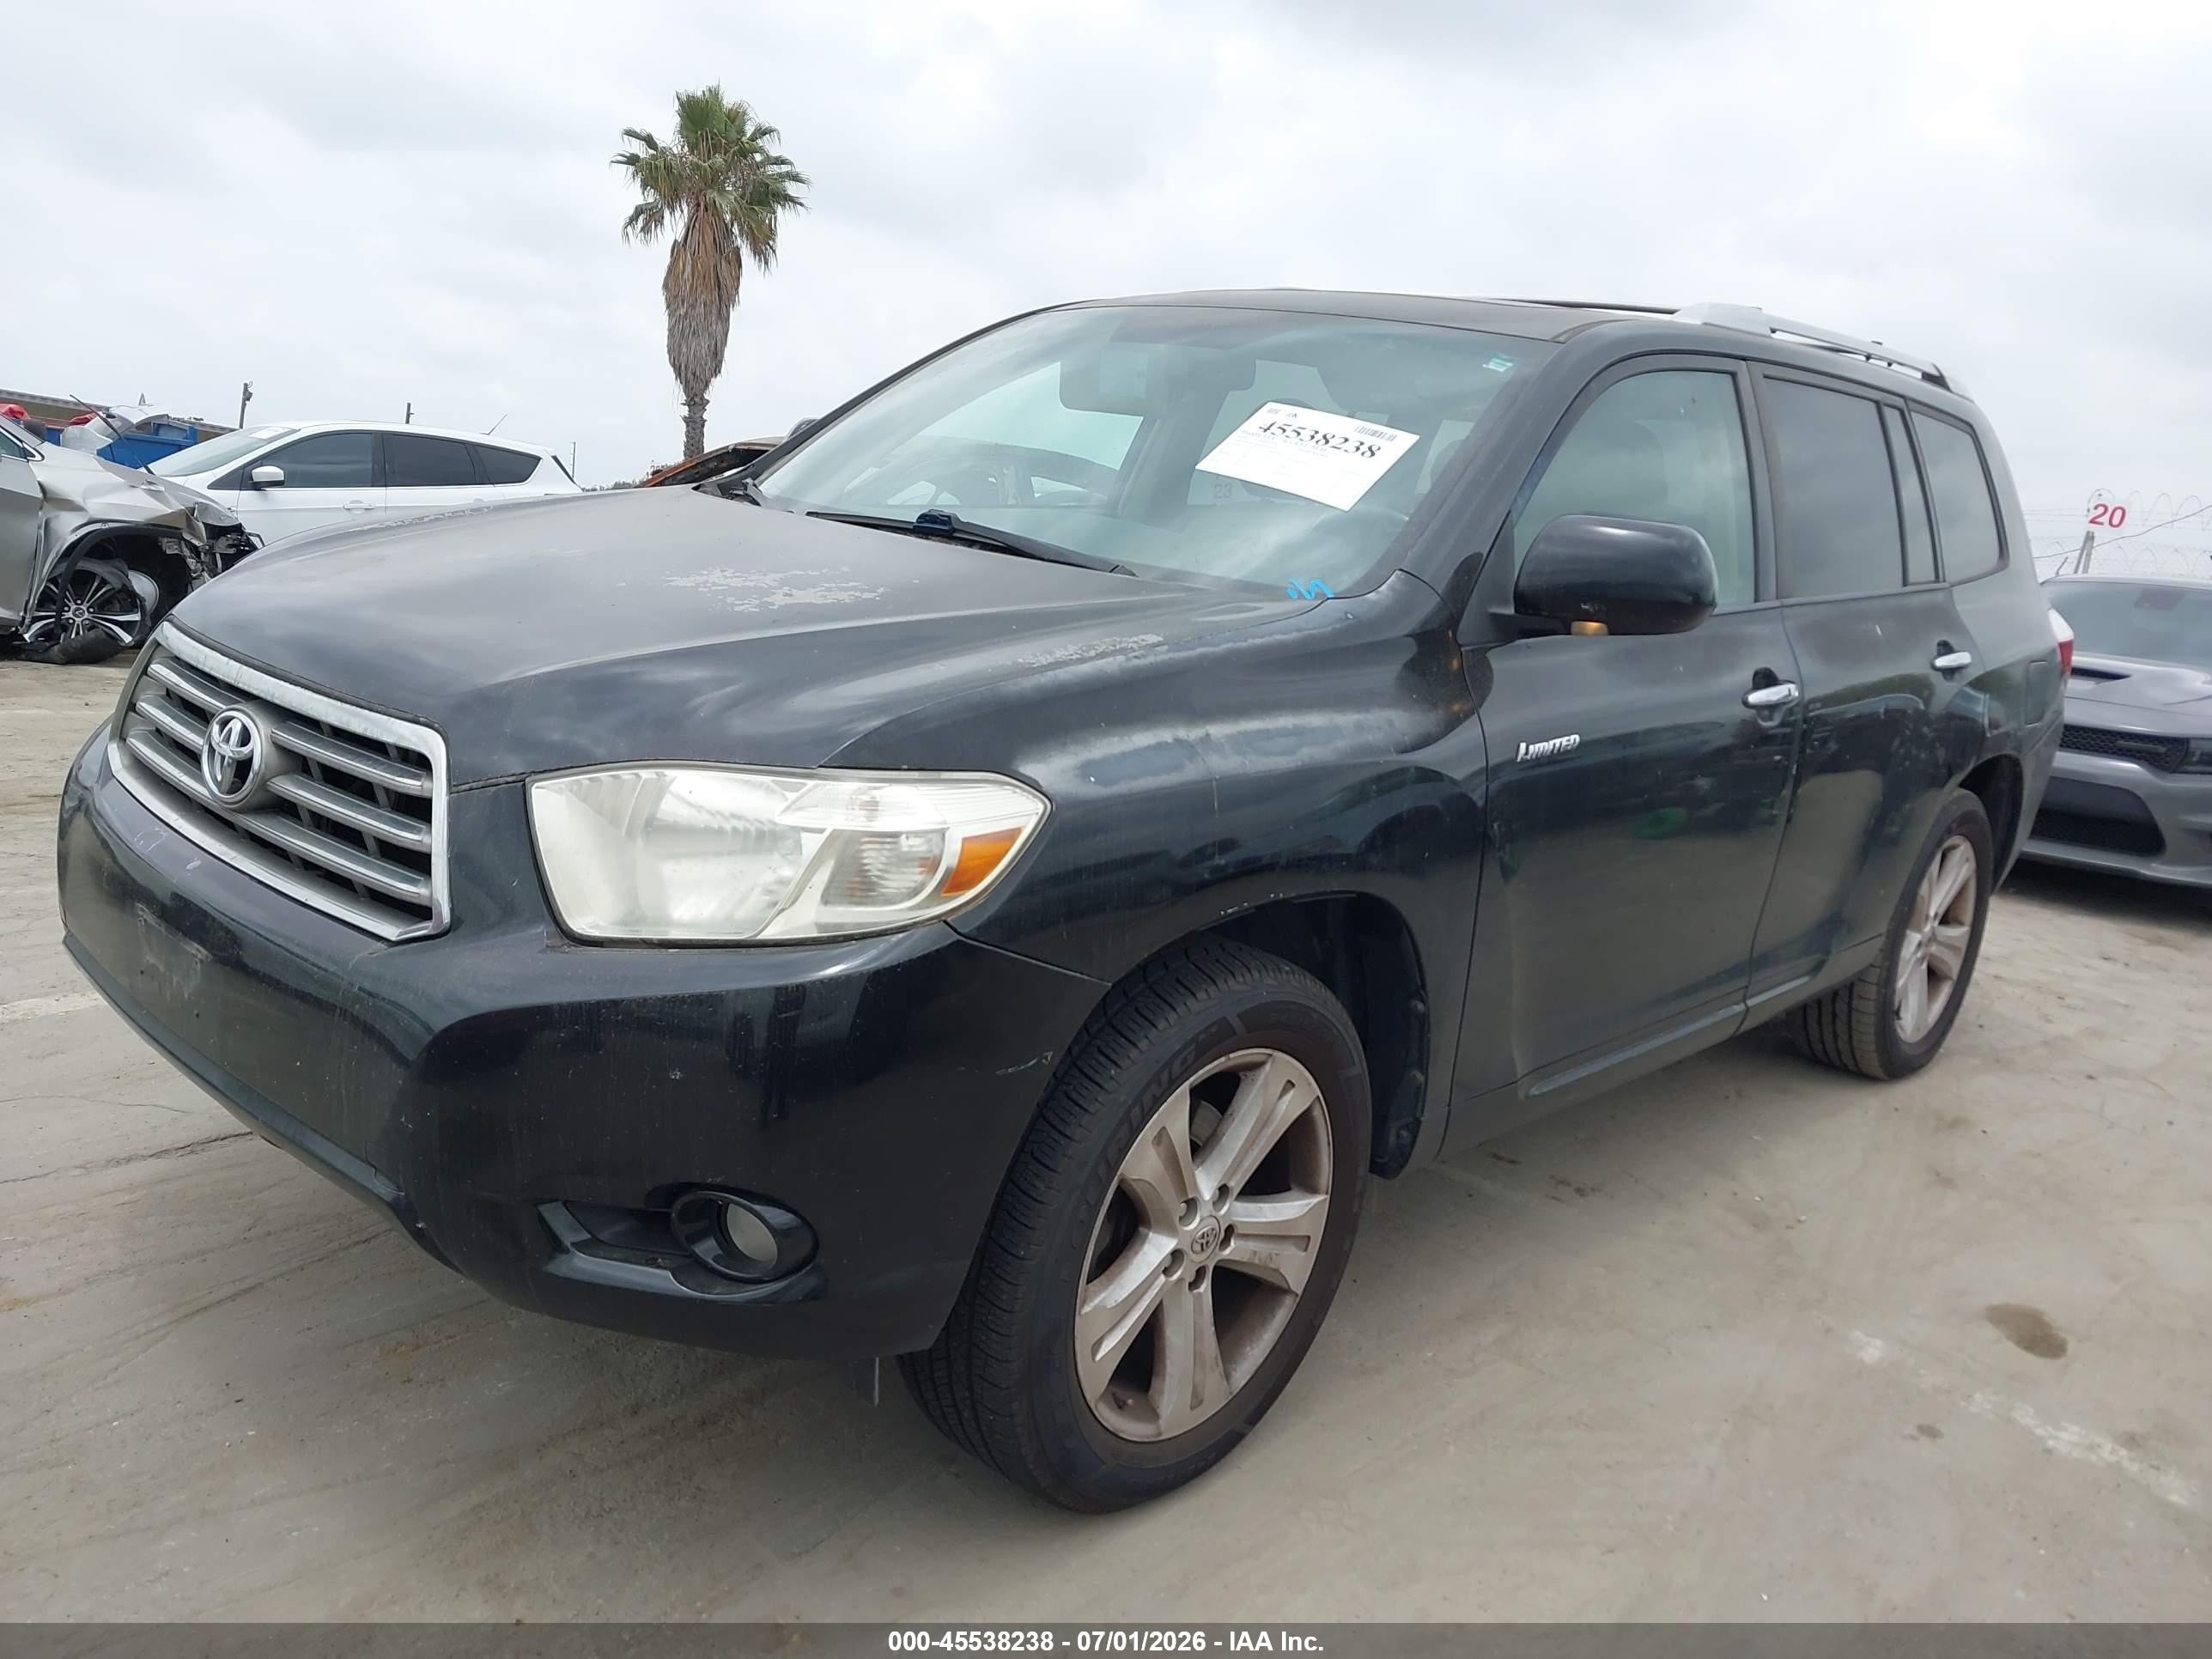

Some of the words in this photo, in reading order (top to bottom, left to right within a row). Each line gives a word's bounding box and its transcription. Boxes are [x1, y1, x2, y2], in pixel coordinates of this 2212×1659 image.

[1257, 421, 1382, 459] 45538238
[2088, 502, 2127, 528] 20
[1516, 733, 1581, 763] LIMITED
